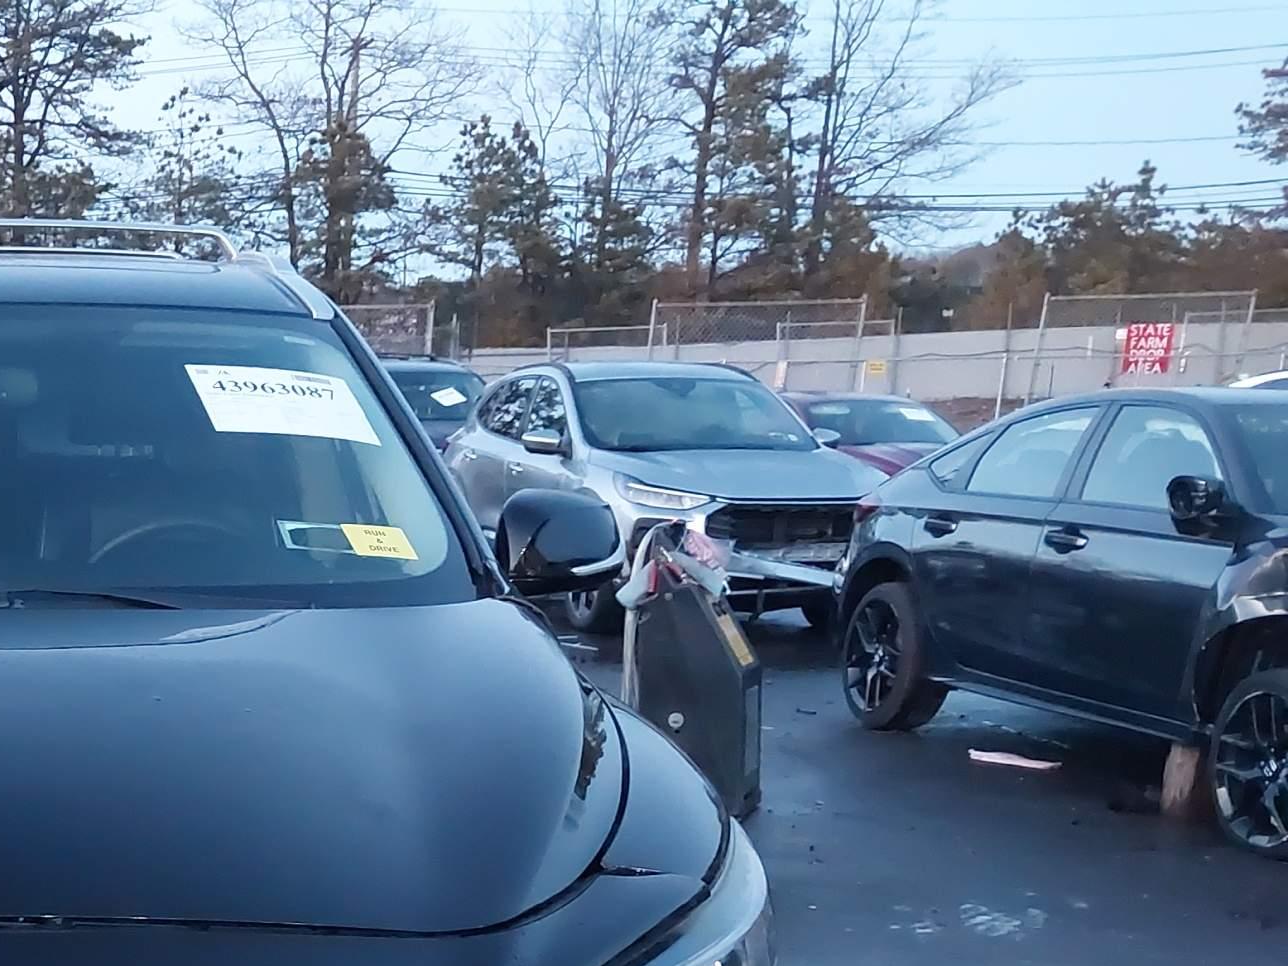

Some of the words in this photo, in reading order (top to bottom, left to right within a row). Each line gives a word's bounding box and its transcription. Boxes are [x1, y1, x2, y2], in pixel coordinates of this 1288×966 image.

[1129, 323, 1172, 336] STATE
[1129, 336, 1169, 349] FARM
[212, 380, 334, 401] 43963087
[363, 529, 387, 537] RUN
[368, 544, 400, 553] DRIVE
